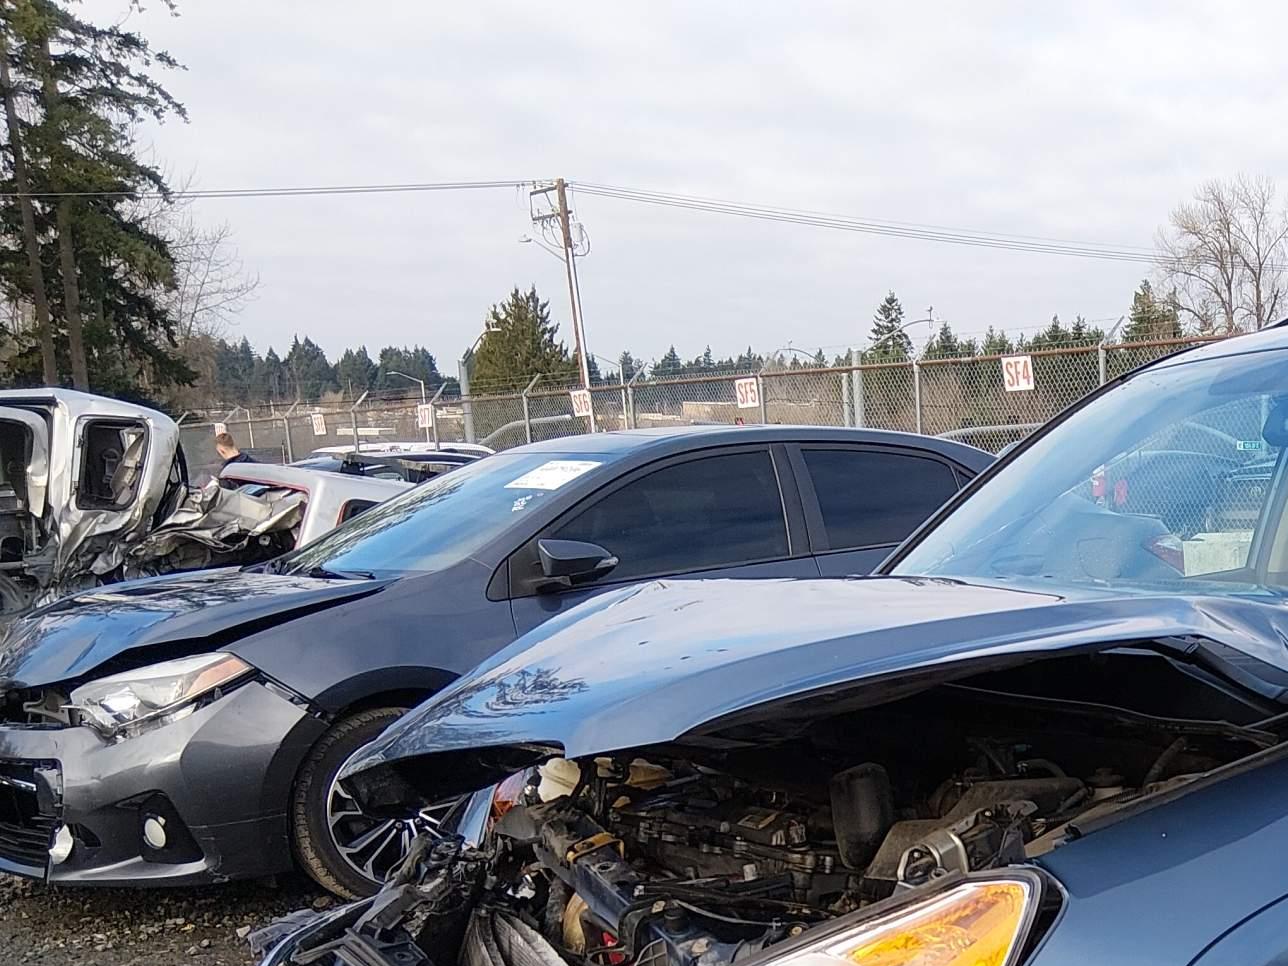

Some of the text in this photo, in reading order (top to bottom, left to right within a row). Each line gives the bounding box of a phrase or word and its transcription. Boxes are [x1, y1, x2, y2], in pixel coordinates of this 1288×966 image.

[1005, 360, 1031, 387] SF4
[572, 392, 590, 414] SF6
[737, 381, 757, 405] SF5
